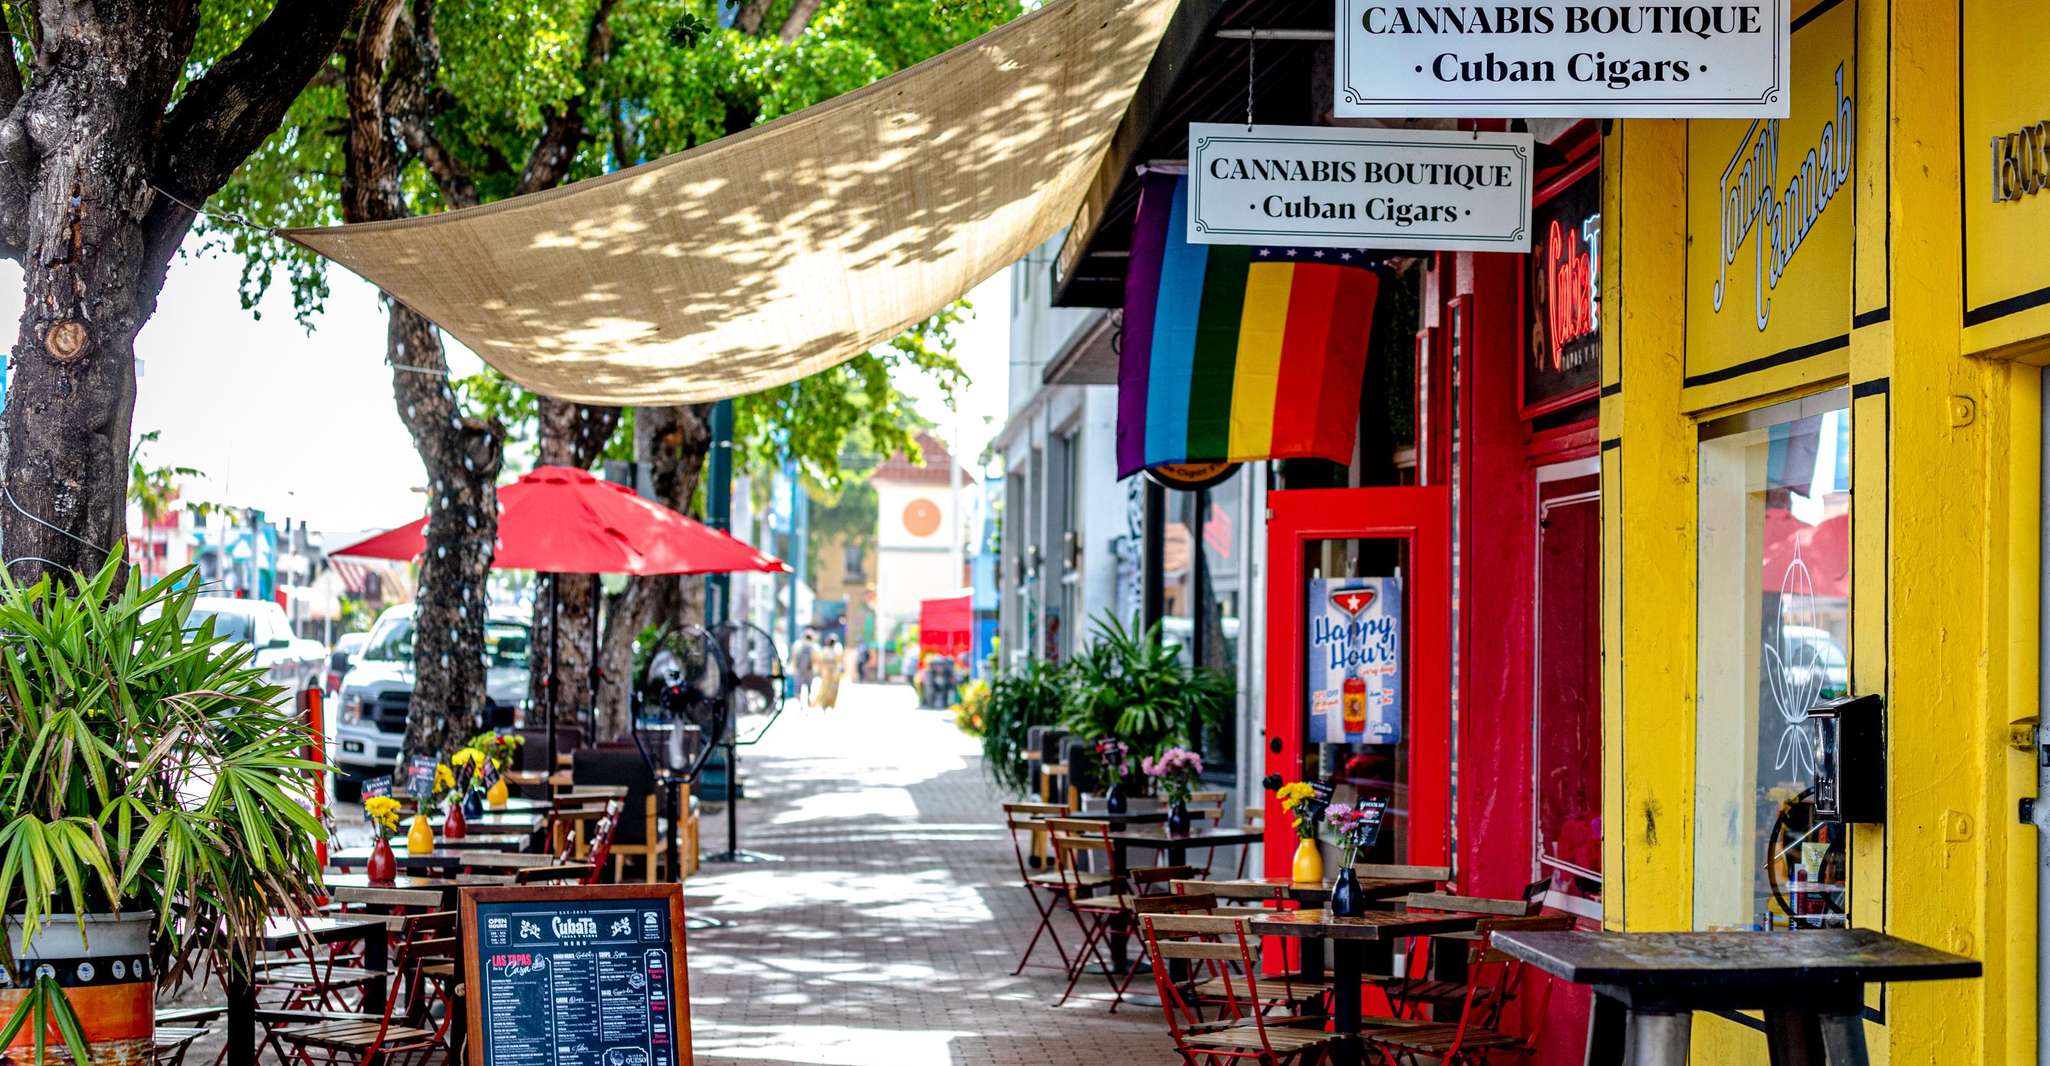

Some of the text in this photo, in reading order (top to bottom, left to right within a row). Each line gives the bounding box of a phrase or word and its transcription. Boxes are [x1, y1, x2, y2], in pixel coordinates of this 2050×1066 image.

[1361, 6, 1762, 40] CANNABIS BOUTIQUE
[1432, 51, 1690, 90] Cuban Cigars
[1210, 157, 1513, 190] CANNABIS BOUTIQUE
[1263, 194, 1458, 227] Cuban Cigars
[1755, 59, 1853, 332] Cannab
[1548, 213, 1601, 369] CubaT
[1315, 617, 1393, 648] Happy
[1330, 634, 1396, 670] Hour!
[491, 953, 532, 967] LAS TAPAS
[504, 960, 532, 977] Casa
